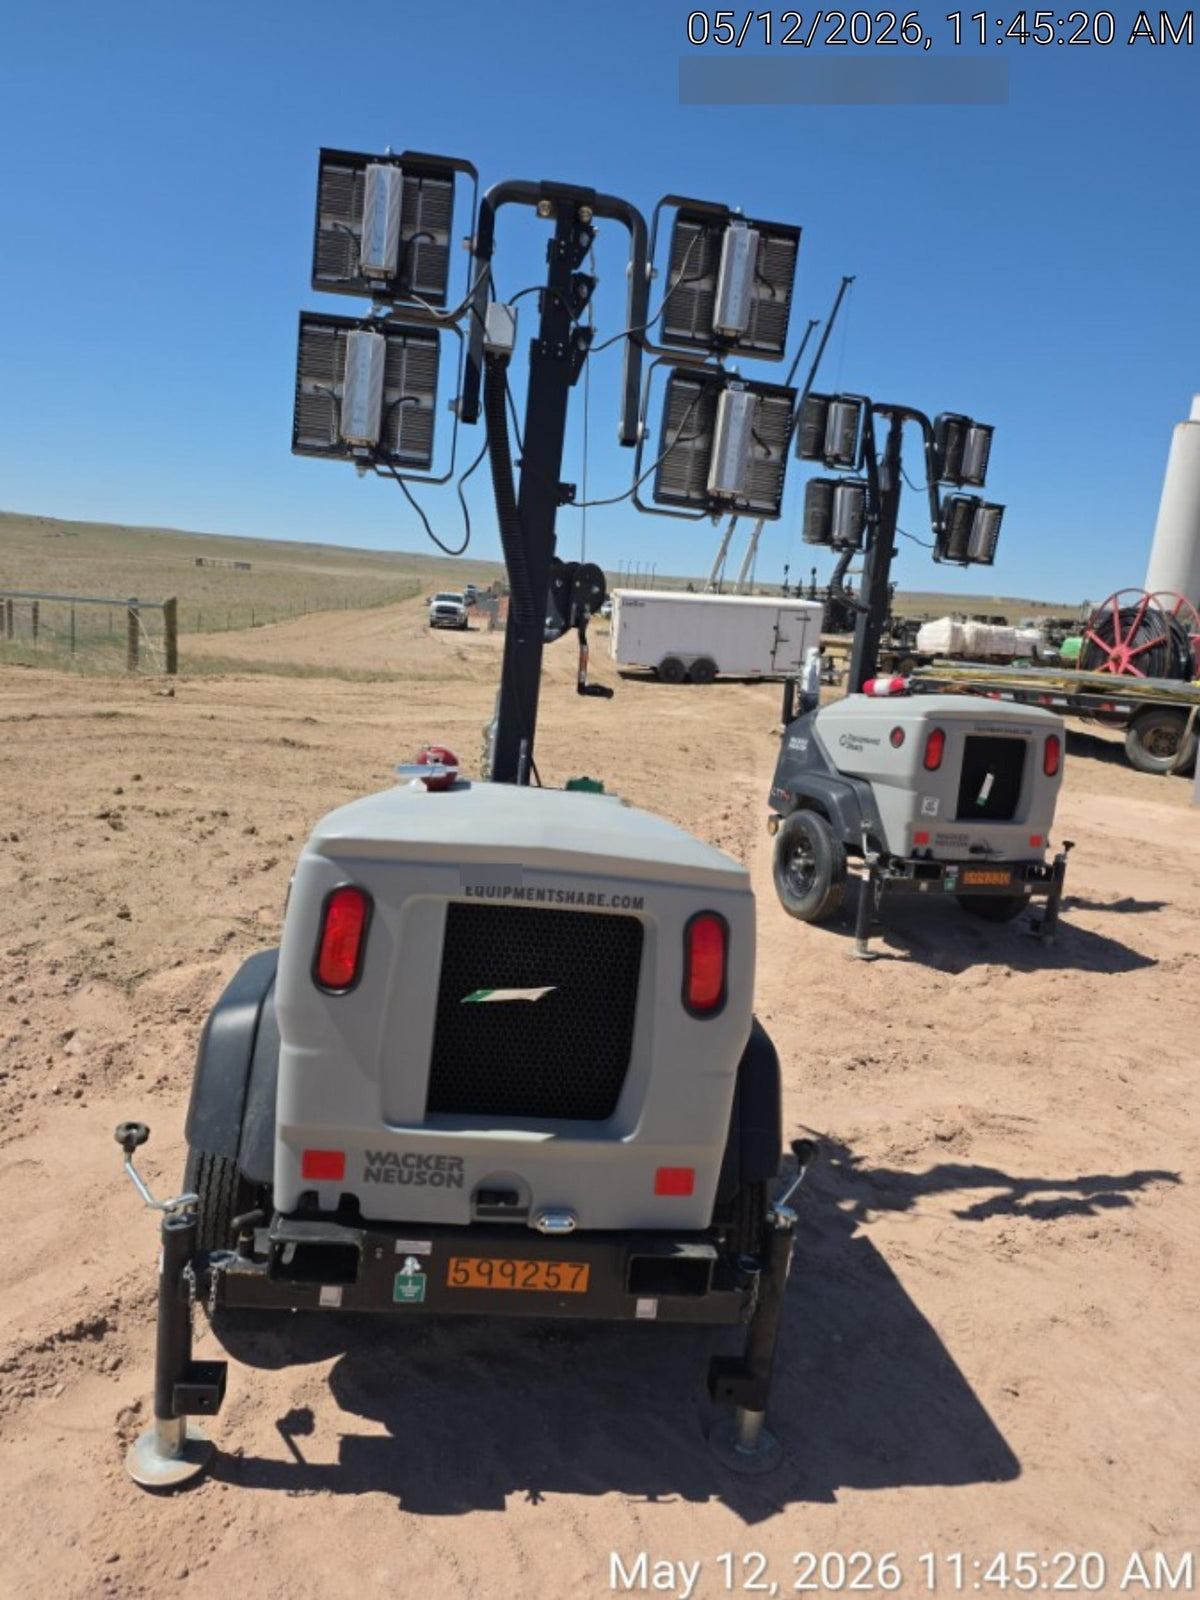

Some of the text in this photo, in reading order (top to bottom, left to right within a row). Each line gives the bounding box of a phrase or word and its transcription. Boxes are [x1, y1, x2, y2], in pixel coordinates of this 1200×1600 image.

[465, 886, 644, 910] EQUIPMENTSHARE.COM
[364, 1150, 464, 1172] WACKER
[363, 1167, 464, 1188] NEUSON
[452, 1258, 585, 1289] 599257
